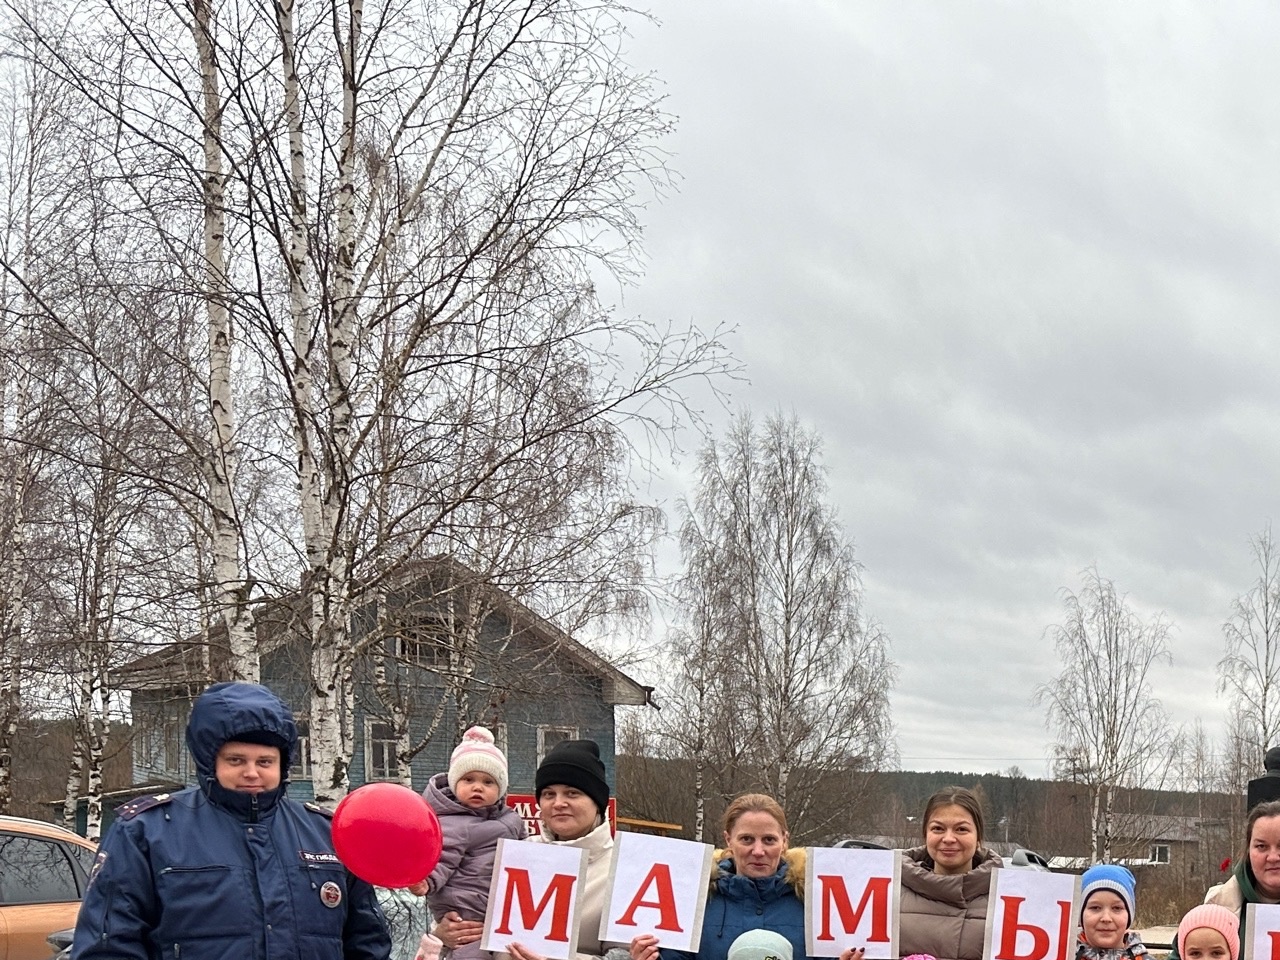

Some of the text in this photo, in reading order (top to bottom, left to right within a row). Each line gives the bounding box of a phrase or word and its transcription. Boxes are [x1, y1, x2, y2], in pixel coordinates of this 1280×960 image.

[495, 867, 577, 943] М
[616, 863, 683, 932] А
[817, 875, 891, 943] М
